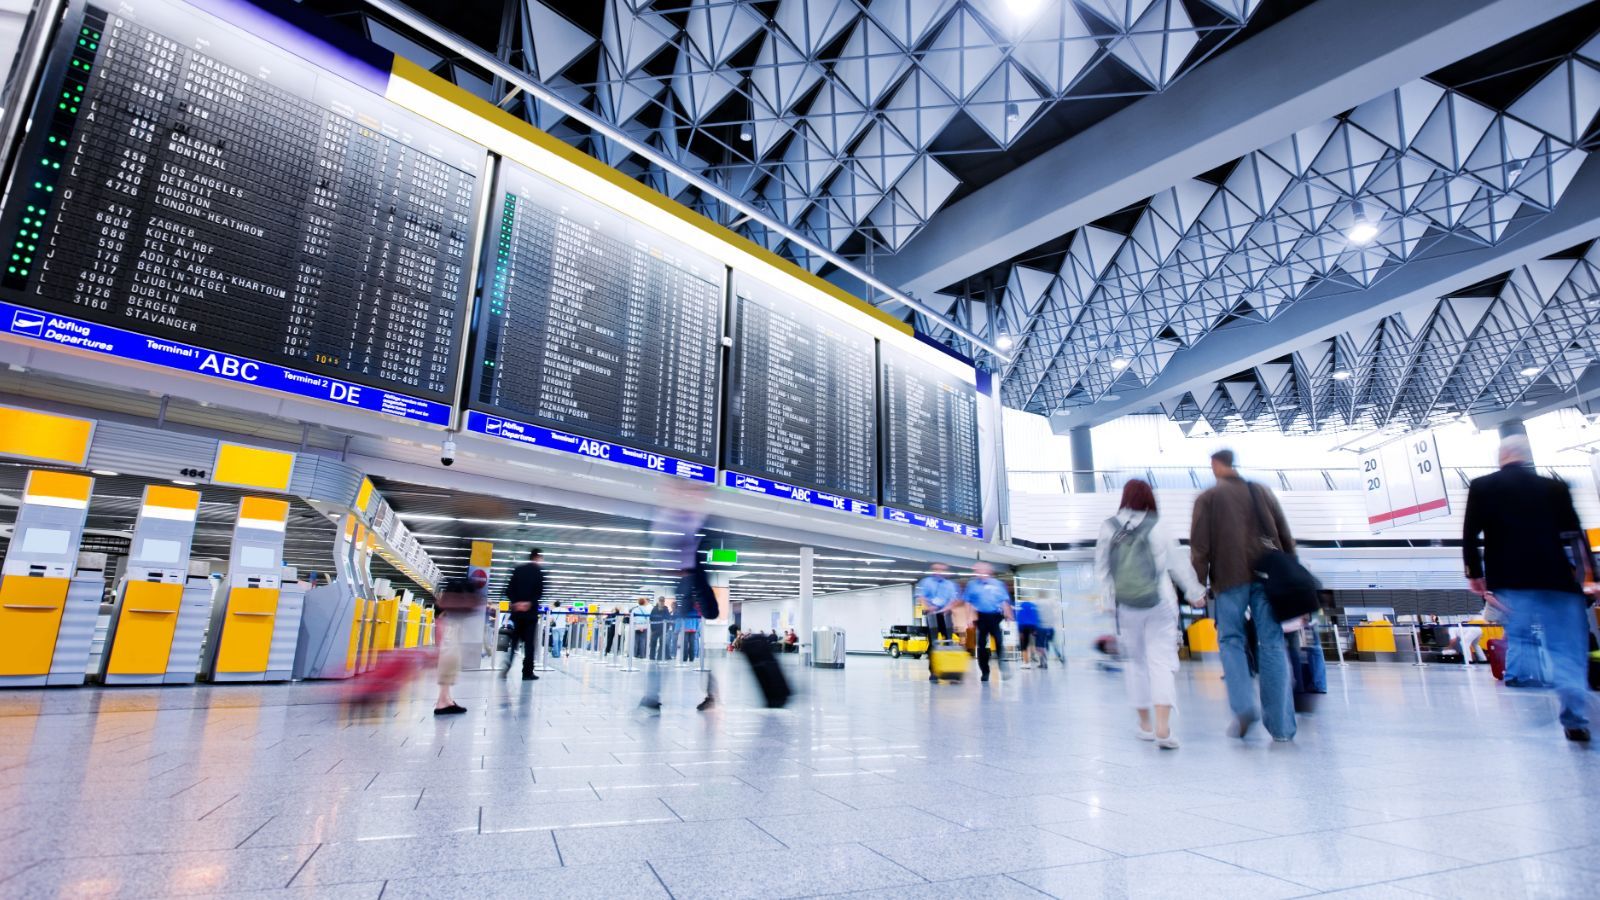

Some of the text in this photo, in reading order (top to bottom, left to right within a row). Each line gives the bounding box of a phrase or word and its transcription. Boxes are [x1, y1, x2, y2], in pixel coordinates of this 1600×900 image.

[144, 42, 175, 62] 3102
[189, 62, 246, 93] HELSINKI
[191, 52, 248, 83] VARADERO
[184, 82, 220, 103] MIAMI
[186, 72, 243, 102] PORTLAND
[129, 128, 153, 143] 875
[168, 142, 227, 171] MONTREAL
[132, 117, 156, 133] 494
[170, 132, 222, 158] CALGARY
[116, 171, 141, 186] 440
[156, 184, 210, 209] HOUSTON
[120, 160, 144, 175] 442
[159, 174, 212, 199] DETROIT
[162, 163, 186, 178] LOS
[192, 174, 243, 198] ANGELES
[107, 204, 132, 219] 417
[148, 217, 195, 238] ZAGREB
[154, 195, 264, 238] LONDON-HEATHROW
[142, 239, 167, 253] TEL
[174, 248, 205, 264] AVIV
[145, 228, 185, 247] KOELN
[192, 242, 214, 256] HBF
[91, 261, 117, 276] 117
[133, 272, 204, 299] LJUBLJANA
[94, 249, 120, 264] 176
[136, 261, 229, 294] BERLIN-TEGEL
[98, 238, 123, 253] 590
[139, 250, 179, 269] ADDIS
[186, 264, 286, 299] ABEBA-KHARTOUM
[76, 282, 111, 299] 3126
[127, 295, 176, 316] BERGEN
[79, 270, 114, 287] 4980
[130, 284, 179, 304] DUBLIN
[47, 318, 91, 336] Abflug
[72, 294, 108, 311] 3160
[124, 307, 197, 332] STAVANGER
[44, 329, 114, 351] Departures
[146, 339, 259, 381] Terminal 1 ABC
[283, 370, 361, 404] Terminal 2 DE
[501, 429, 536, 443] Departures
[502, 421, 524, 433] Abflug
[551, 432, 573, 444] Terminal
[578, 440, 610, 459] ABC
[622, 448, 642, 459] Terminal
[647, 454, 665, 471] DE
[1413, 440, 1427, 454] 10
[180, 468, 205, 478] 464
[1364, 458, 1377, 472] 20
[1417, 459, 1432, 474] 10
[791, 488, 810, 502] ABC
[1367, 477, 1380, 491] 20
[833, 497, 845, 509] DE
